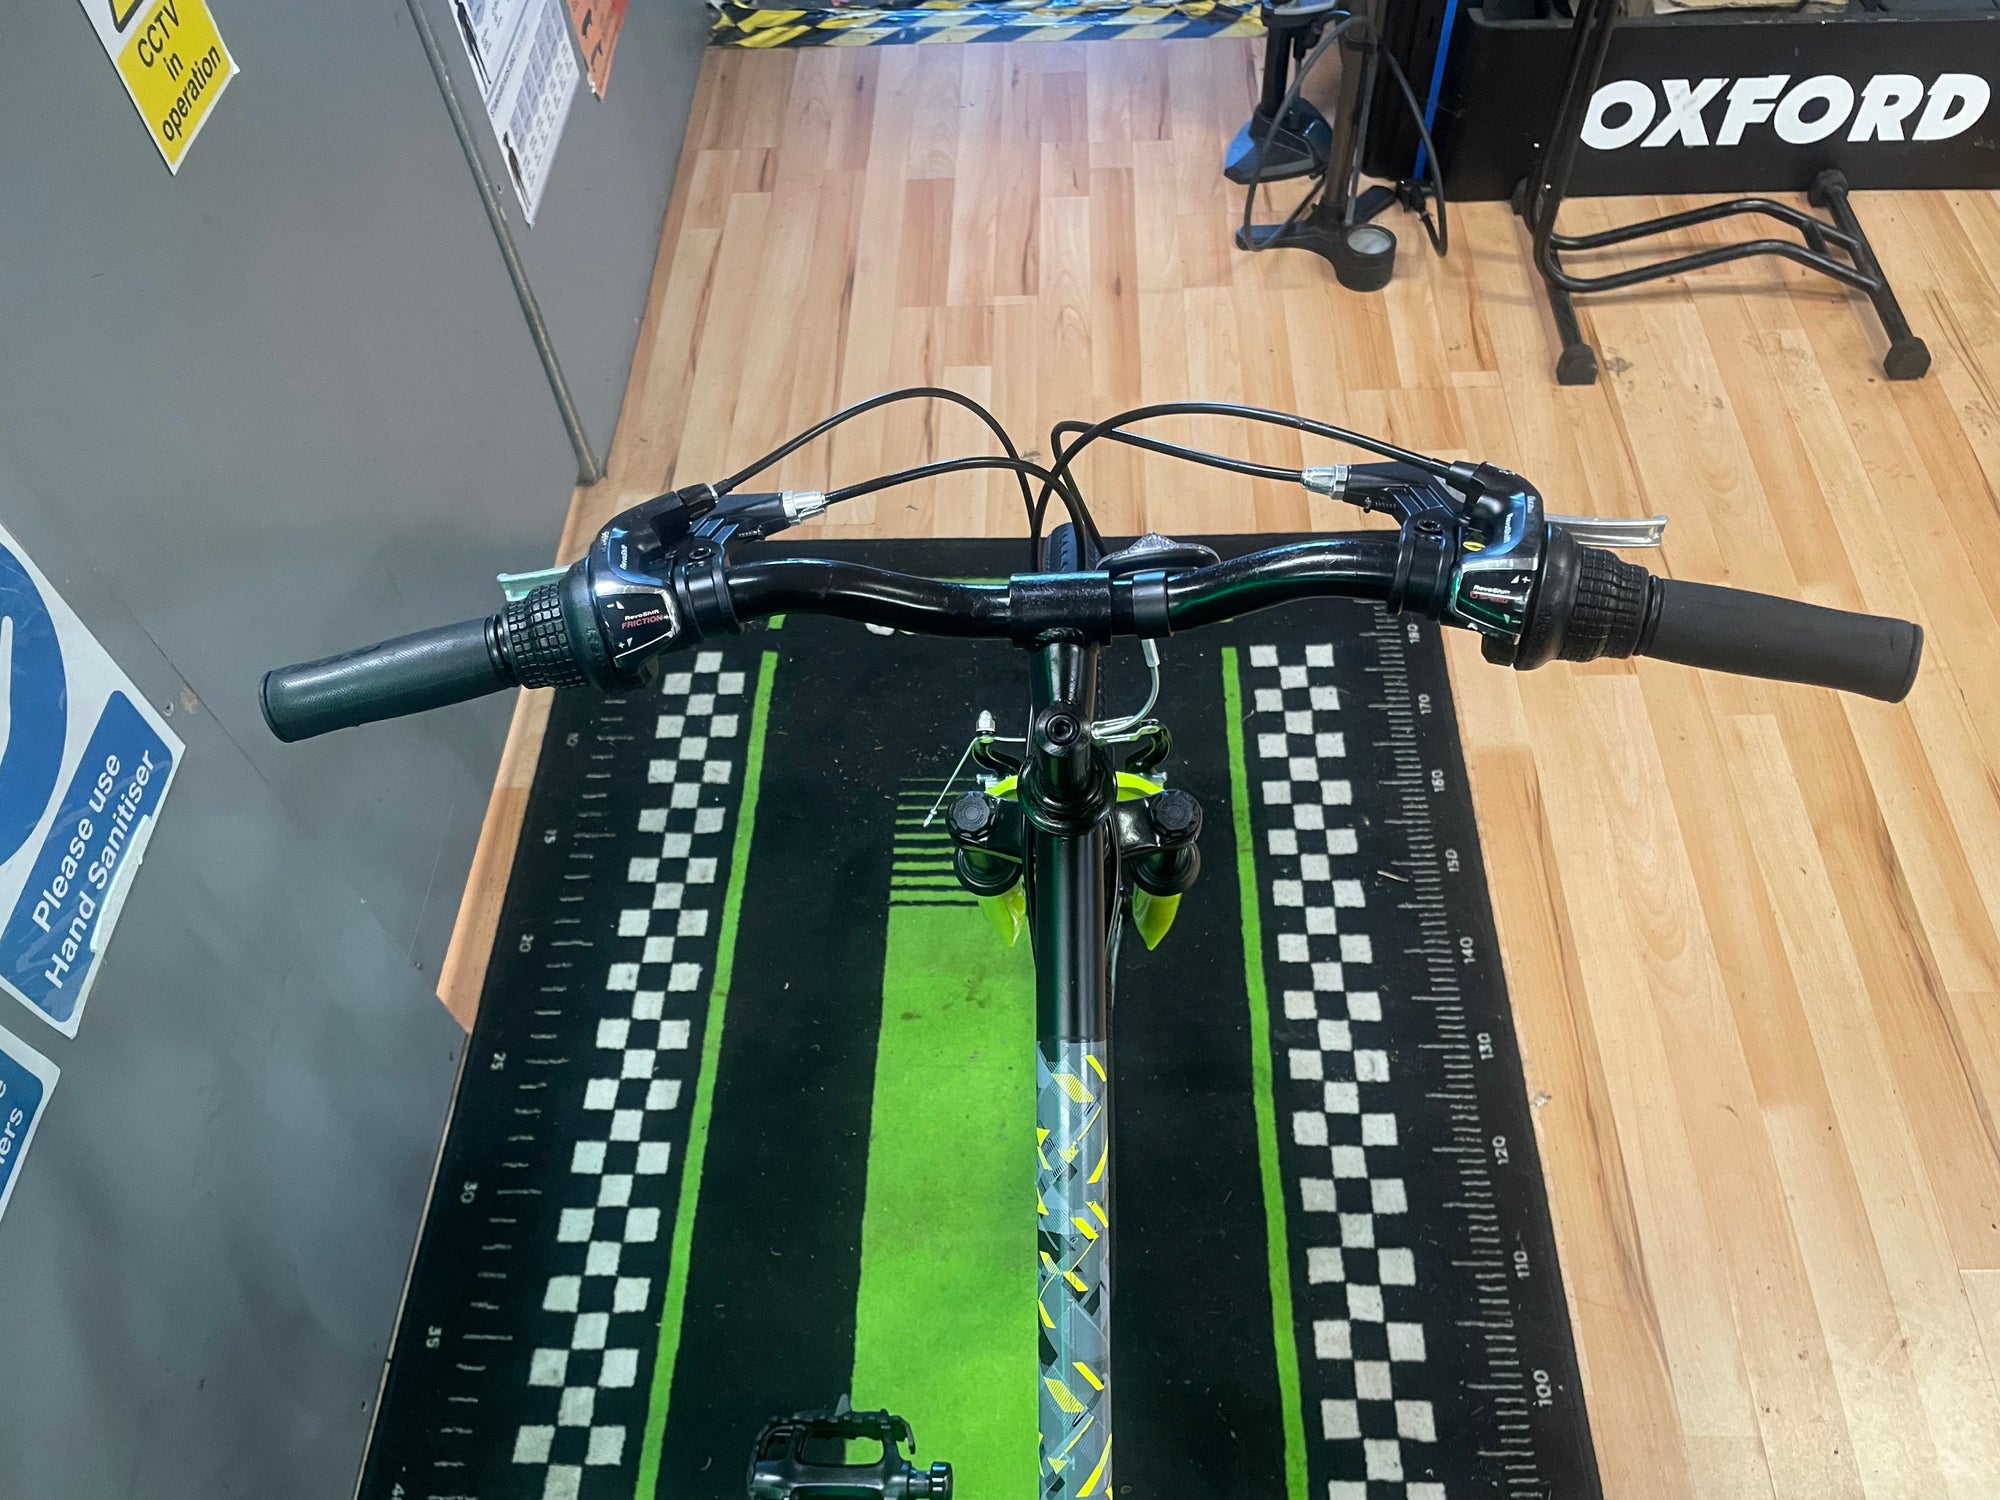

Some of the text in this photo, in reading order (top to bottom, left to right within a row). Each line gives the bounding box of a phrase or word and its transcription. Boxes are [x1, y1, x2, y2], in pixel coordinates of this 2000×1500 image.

[137, 0, 179, 68] CCTV
[163, 53, 184, 81] in
[162, 45, 221, 142] operation
[1581, 73, 1991, 150] OXFORD
[621, 614, 663, 630] FRICTION
[624, 609, 660, 621] RevoShift
[1406, 623, 1420, 644] 180
[1417, 693, 1432, 715] 170
[1431, 769, 1445, 793] 160
[32, 754, 121, 933] Please use
[44, 750, 155, 989] Hand Sanitiser
[1445, 848, 1460, 873] 150
[519, 934, 535, 953] 20
[1459, 936, 1476, 964] 140
[1476, 1032, 1494, 1060] 130
[490, 1052, 507, 1070] 25
[1492, 1135, 1509, 1165] 120
[460, 1181, 478, 1204] 30
[1513, 1250, 1530, 1278] 110
[425, 1325, 442, 1348] 35
[1533, 1369, 1553, 1408] 100
